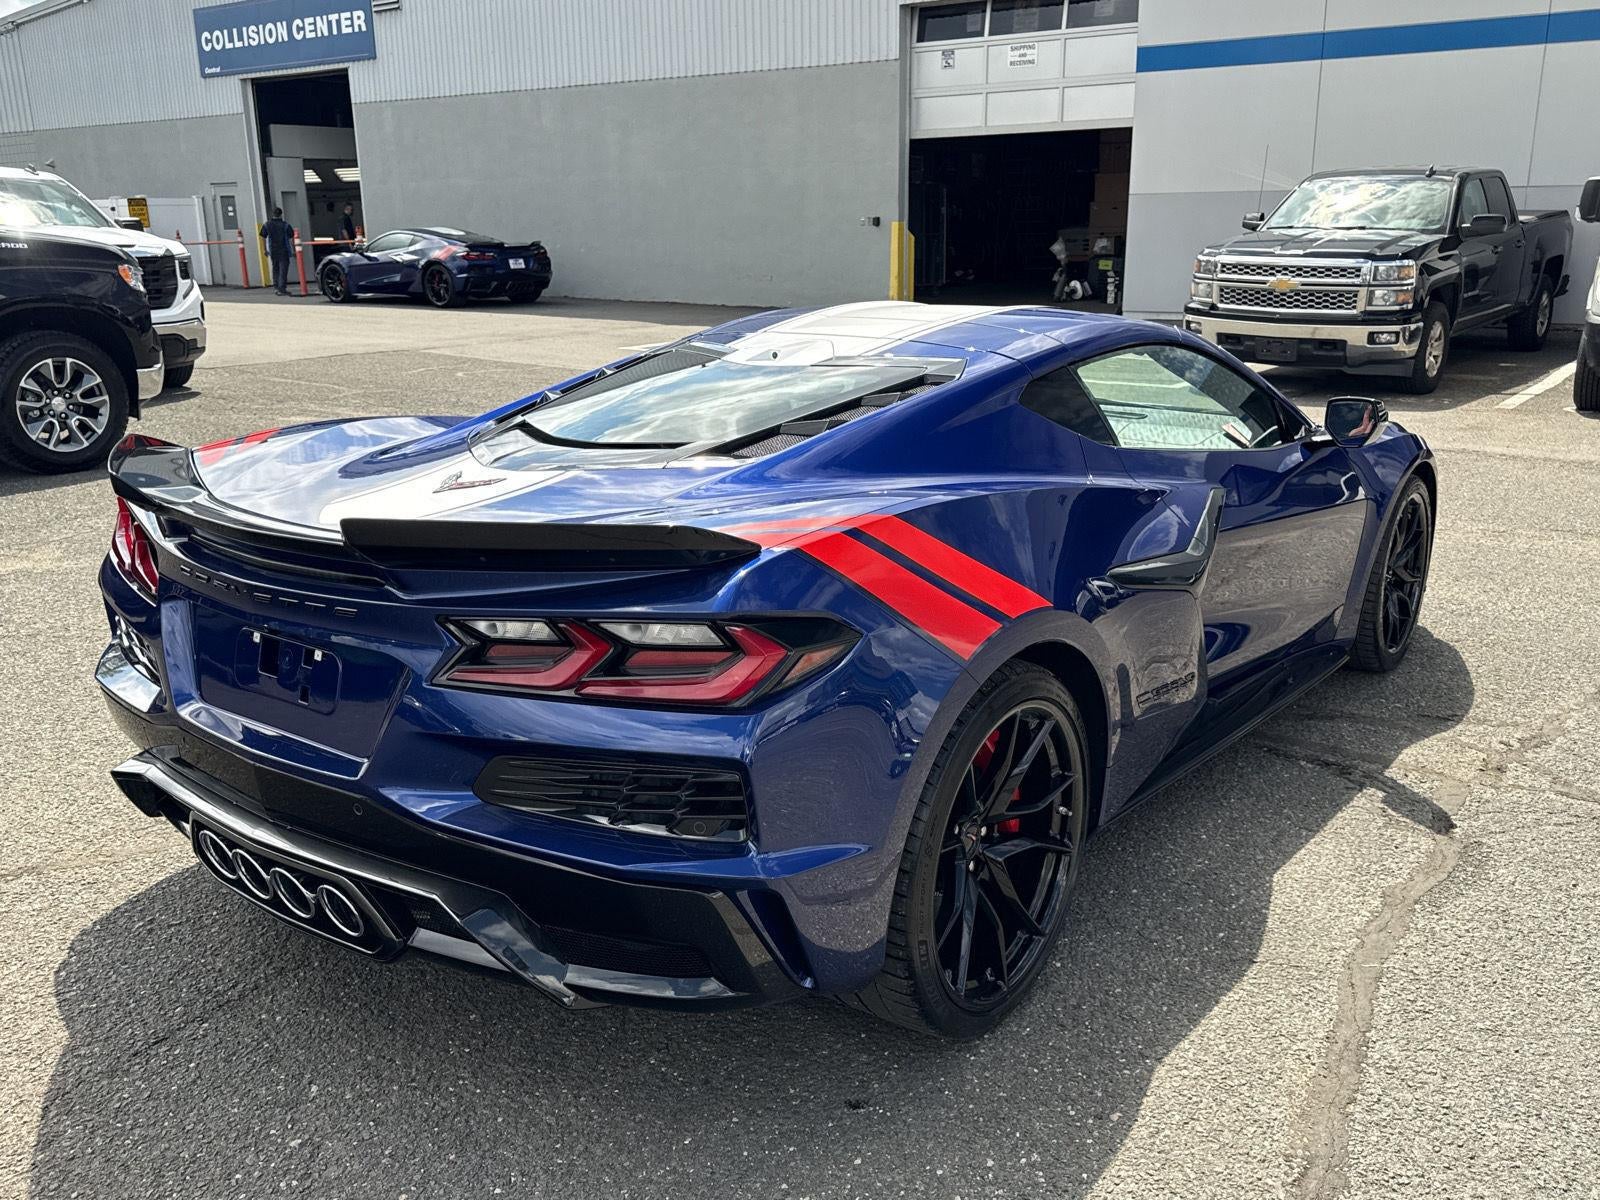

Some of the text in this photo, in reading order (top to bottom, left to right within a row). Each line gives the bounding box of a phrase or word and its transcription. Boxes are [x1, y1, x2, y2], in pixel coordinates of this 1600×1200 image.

[201, 10, 367, 52] COLLISION CENTER
[1010, 44, 1036, 52] SHIPPING
